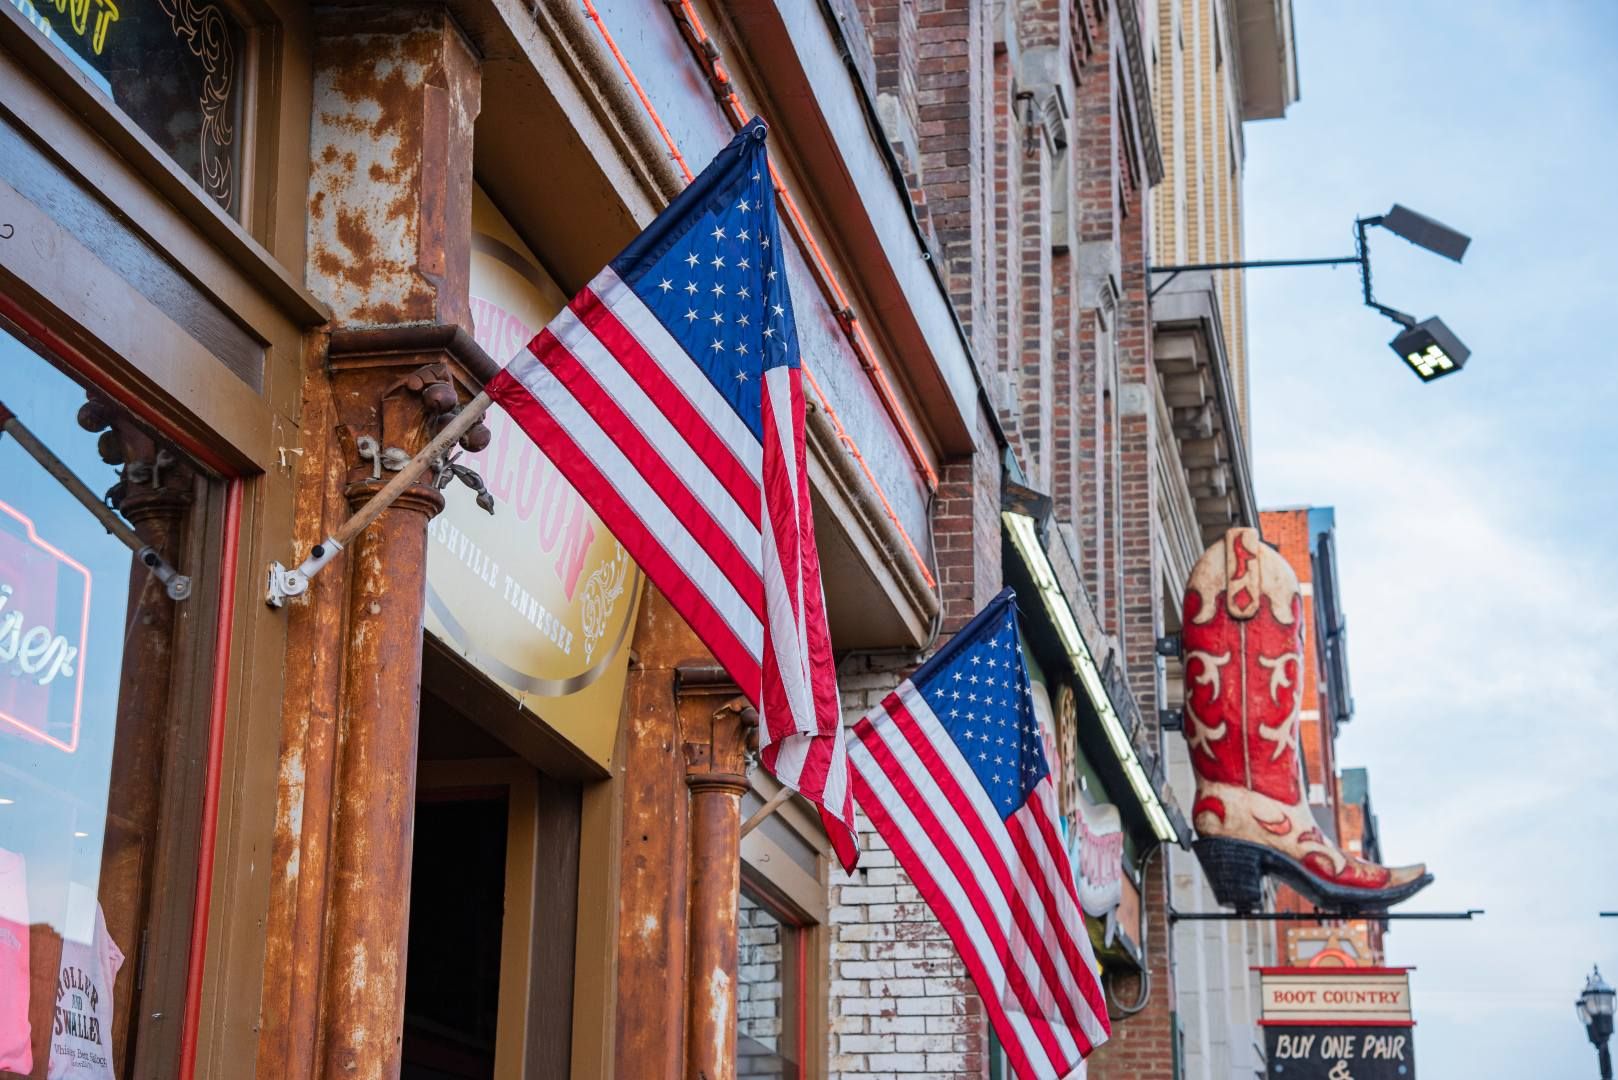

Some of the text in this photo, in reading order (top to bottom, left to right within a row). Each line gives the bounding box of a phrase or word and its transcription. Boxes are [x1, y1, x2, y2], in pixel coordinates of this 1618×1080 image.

[451, 402, 595, 604] ALOON
[427, 516, 574, 656] ASHVILLE TENNESSEE
[1274, 991, 1401, 1004] BOOT COUNTRY
[1275, 1034, 1406, 1061] BUY ONE PAIR
